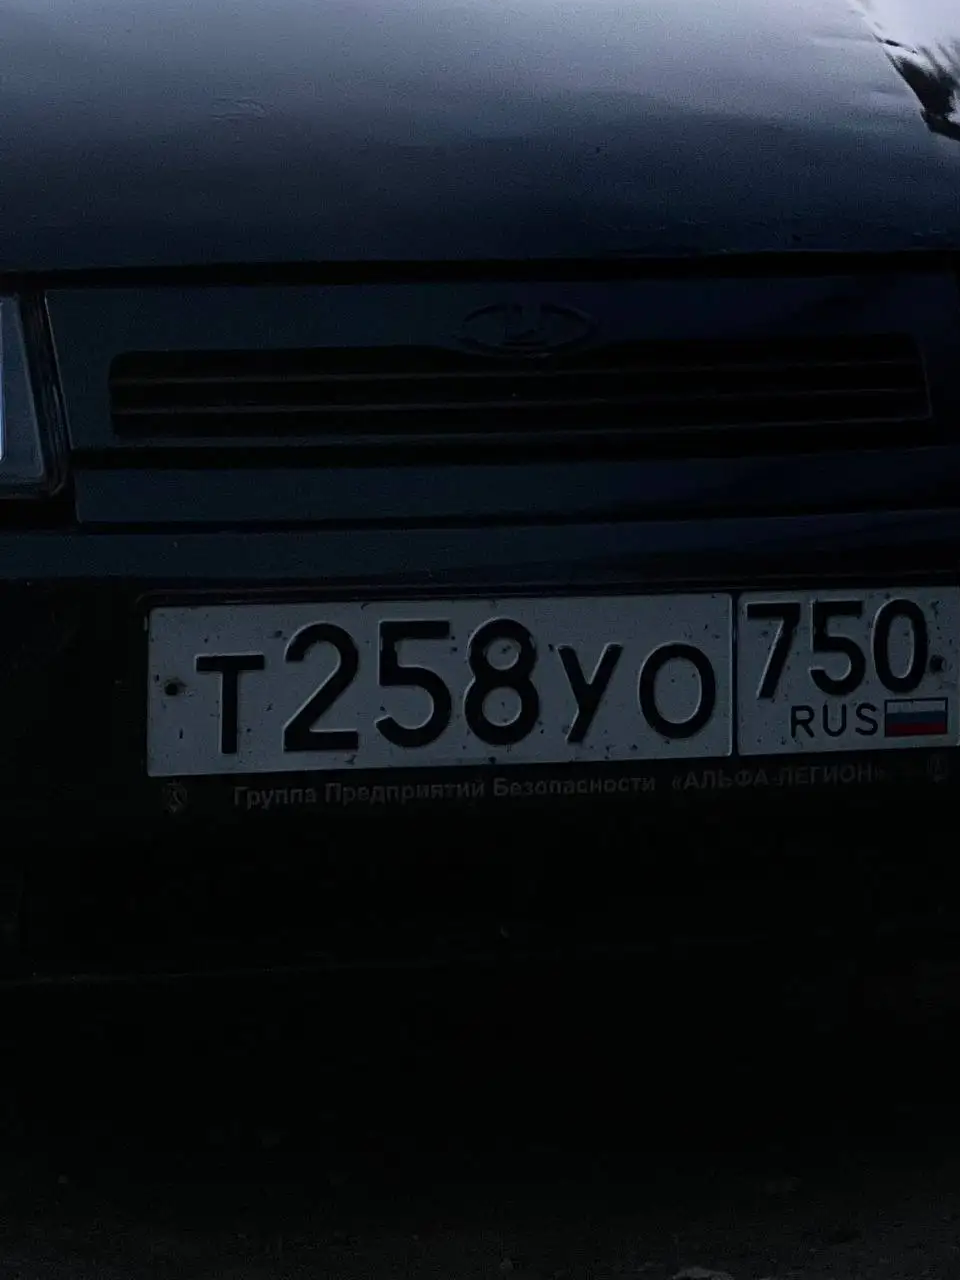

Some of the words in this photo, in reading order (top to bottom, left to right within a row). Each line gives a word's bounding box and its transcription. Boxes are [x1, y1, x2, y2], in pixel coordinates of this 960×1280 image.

[745, 599, 927, 699] 750
[790, 701, 878, 737] RUS
[234, 785, 317, 810] Группа
[325, 778, 486, 806] Предприятий
[494, 776, 656, 797] Безопасности
